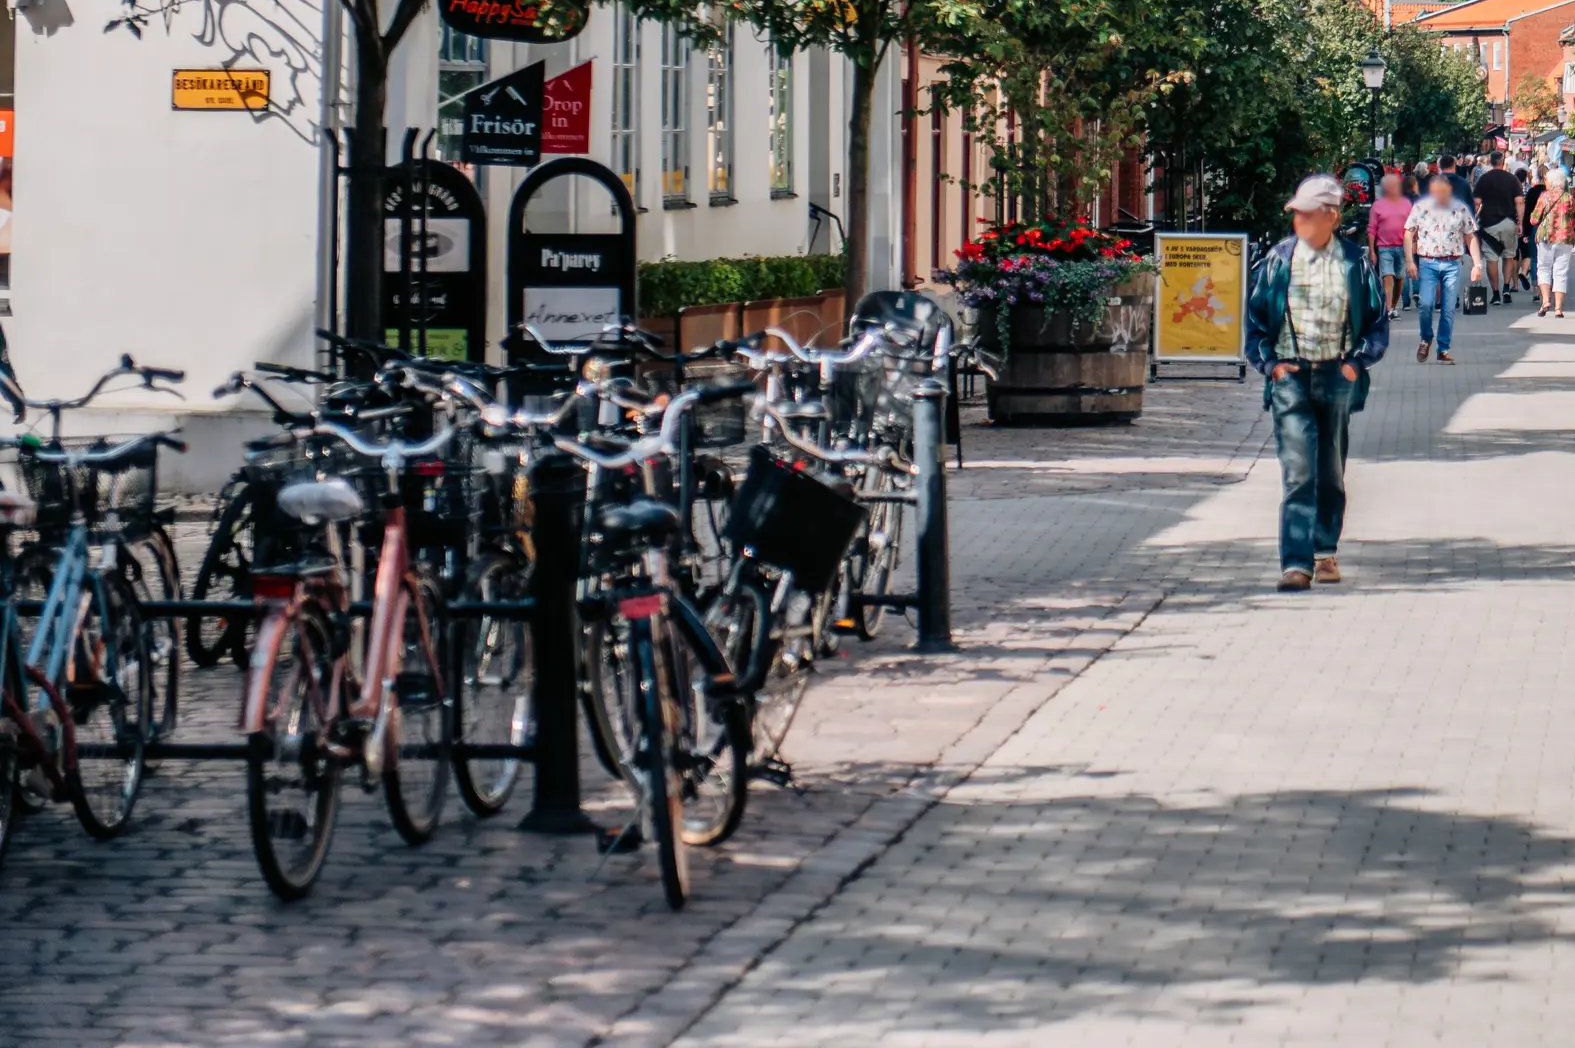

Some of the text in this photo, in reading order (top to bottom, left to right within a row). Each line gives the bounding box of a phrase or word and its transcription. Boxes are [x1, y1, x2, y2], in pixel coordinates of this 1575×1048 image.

[542, 95, 583, 115] Drop
[470, 114, 536, 136] Frisör
[551, 113, 569, 128] in
[469, 145, 534, 156] Välkommen in
[541, 248, 601, 272] Pa'parey
[528, 303, 617, 324] Annexet
